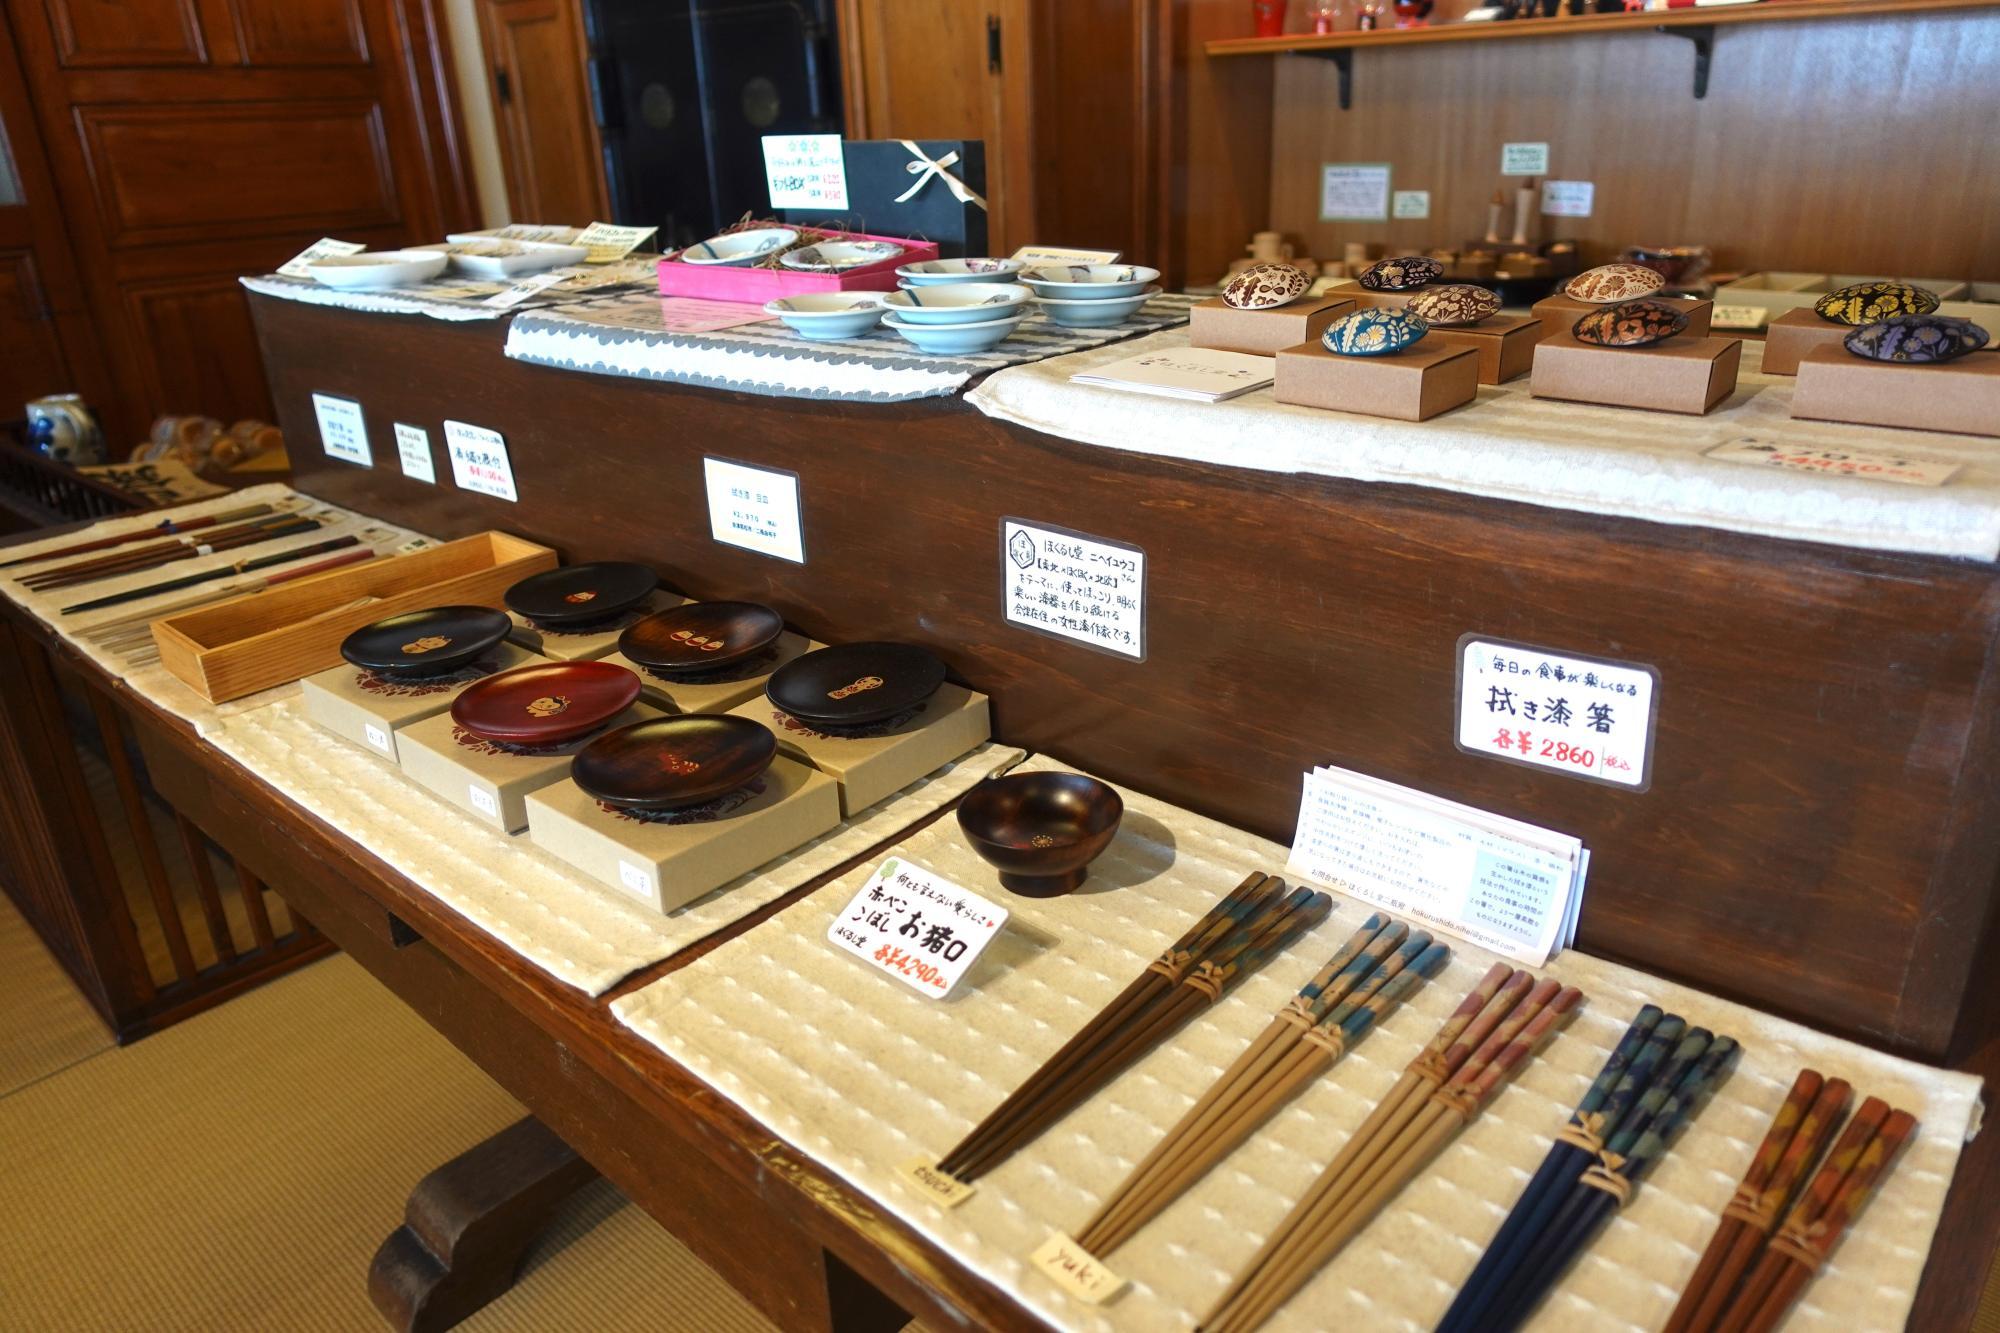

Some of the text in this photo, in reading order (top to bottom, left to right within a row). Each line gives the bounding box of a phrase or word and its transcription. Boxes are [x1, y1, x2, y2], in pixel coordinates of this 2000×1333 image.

[1044, 539, 1135, 572] ほくるし堂 ニヘイユウコ
[1493, 654, 1638, 696] 毎日の食事が楽しくなる
[868, 885, 908, 914] 赤べこ
[836, 926, 868, 949] ほくるし堂
[898, 911, 968, 962] お猪口
[1411, 907, 1516, 952] hokurushido.nihei@gmail.com
[1047, 1248, 1105, 1290] yuki
